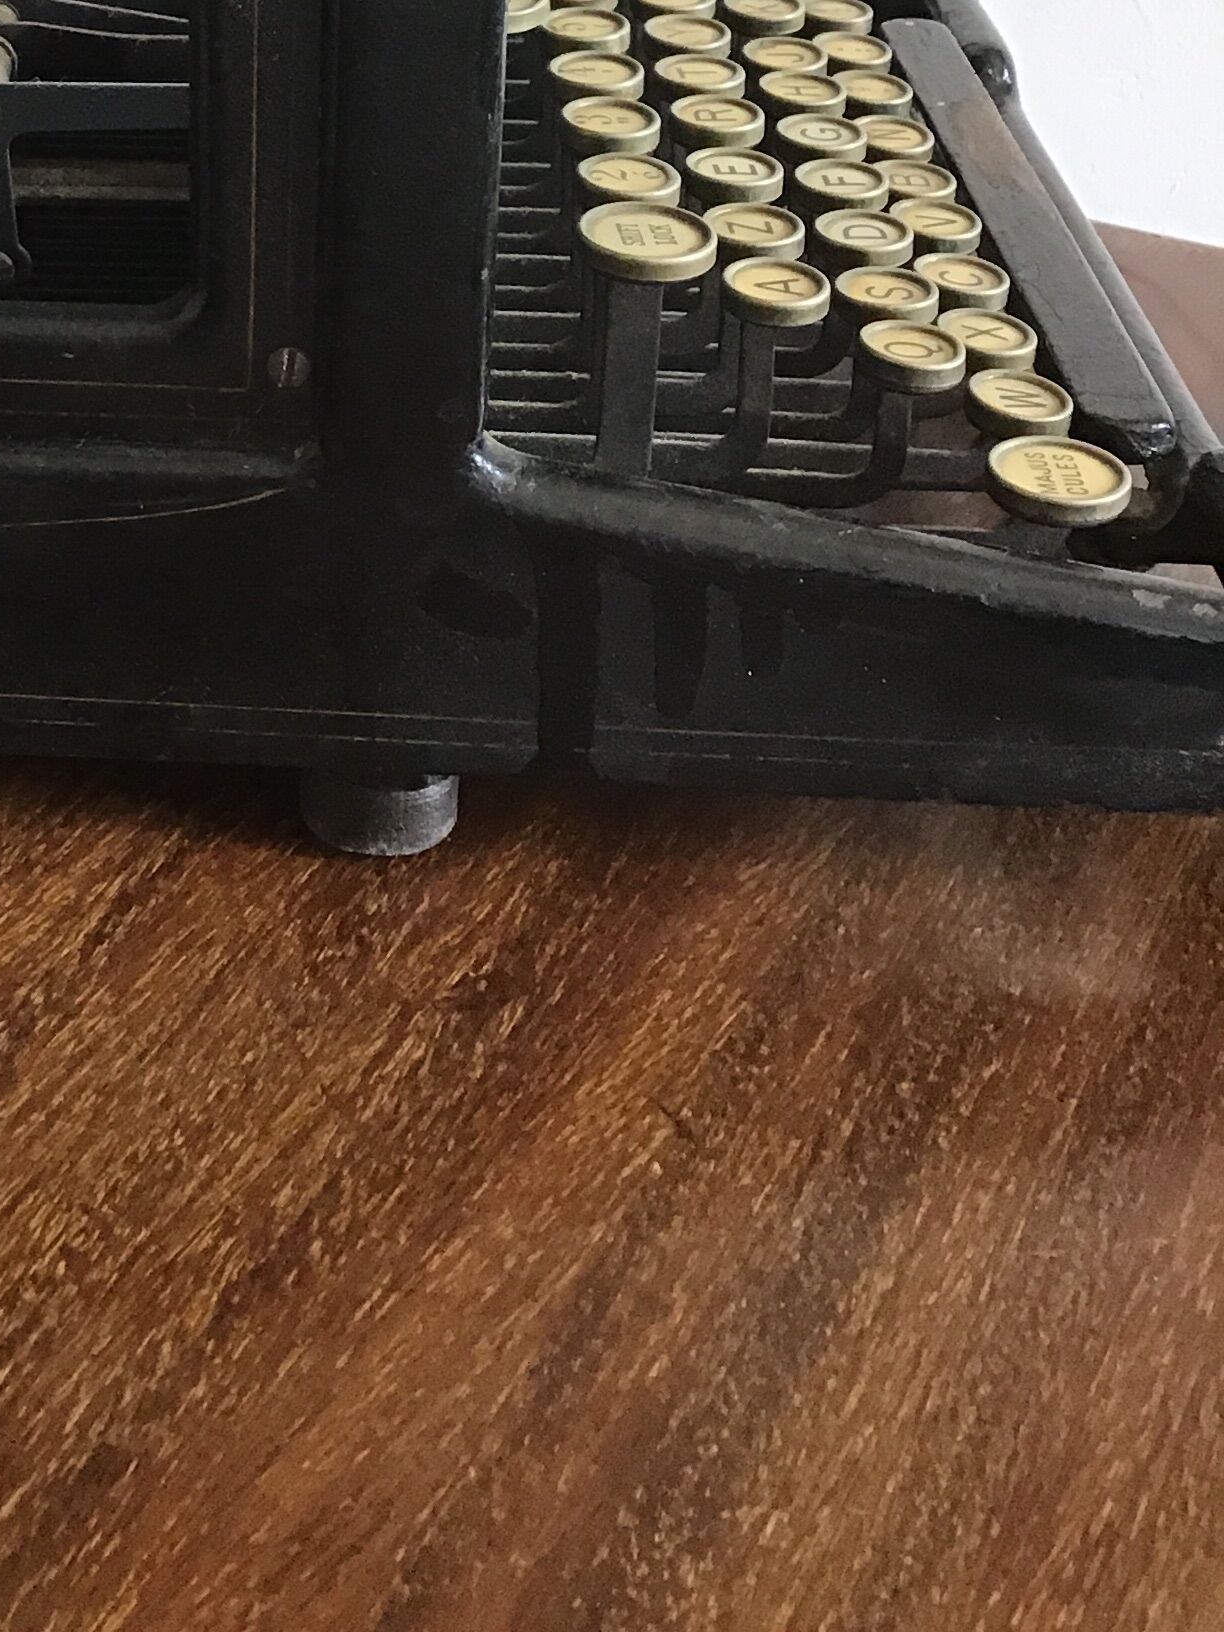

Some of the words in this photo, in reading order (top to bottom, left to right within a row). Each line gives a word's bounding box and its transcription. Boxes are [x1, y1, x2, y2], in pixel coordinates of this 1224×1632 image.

[766, 52, 805, 63] J
[675, 66, 718, 79] T
[781, 85, 822, 97] H
[575, 114, 612, 125] 3
[694, 108, 737, 121] R
[799, 127, 843, 142] G
[870, 127, 912, 141] N
[591, 169, 629, 182] 2
[711, 163, 759, 175] E
[821, 174, 867, 187] F
[889, 173, 931, 187] B
[726, 220, 775, 235] Z
[914, 215, 958, 228] V
[842, 224, 888, 240] D
[938, 270, 984, 287] C
[753, 277, 805, 296] A
[865, 285, 915, 301] S
[960, 324, 1009, 341] X
[883, 340, 944, 360] Q
[994, 386, 1048, 408] W
[1024, 451, 1060, 495] MAJUS
[1052, 453, 1090, 496] CULES
